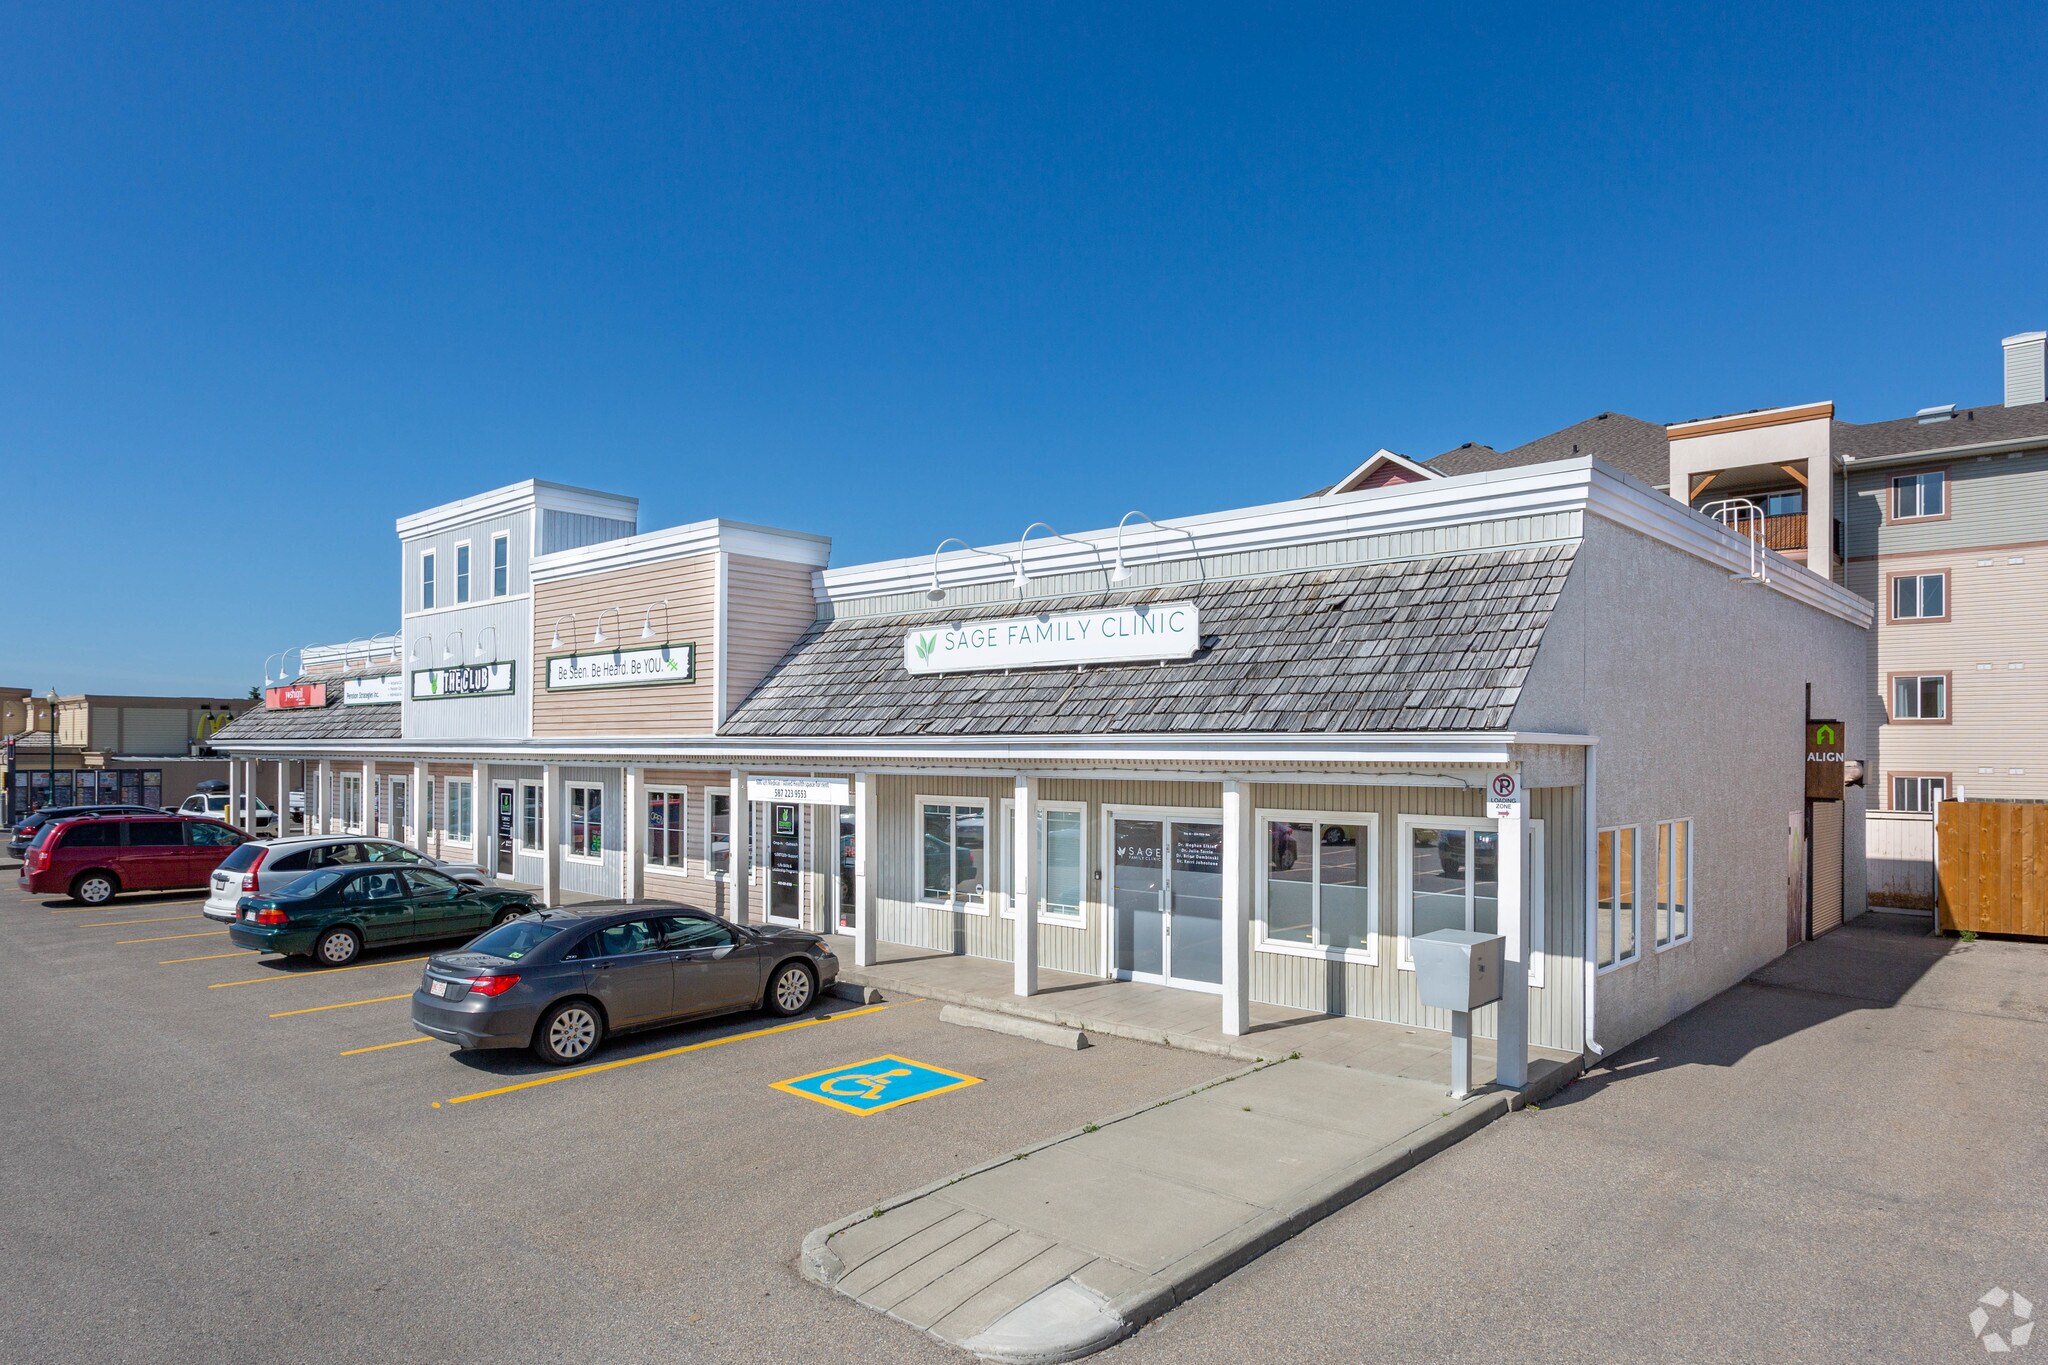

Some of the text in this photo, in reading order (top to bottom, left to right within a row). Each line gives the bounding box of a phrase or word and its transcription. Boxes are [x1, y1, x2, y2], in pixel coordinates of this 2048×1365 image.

[945, 611, 1186, 651] SAGE FAMILY CLINIC
[558, 657, 664, 680] Be Seen. Be Heard. Be YOU.
[444, 667, 489, 692] THE CLUB
[1807, 752, 1844, 762] ALIGN
[774, 789, 807, 798] 587 223 9553
[1128, 846, 1161, 858] SAGE
